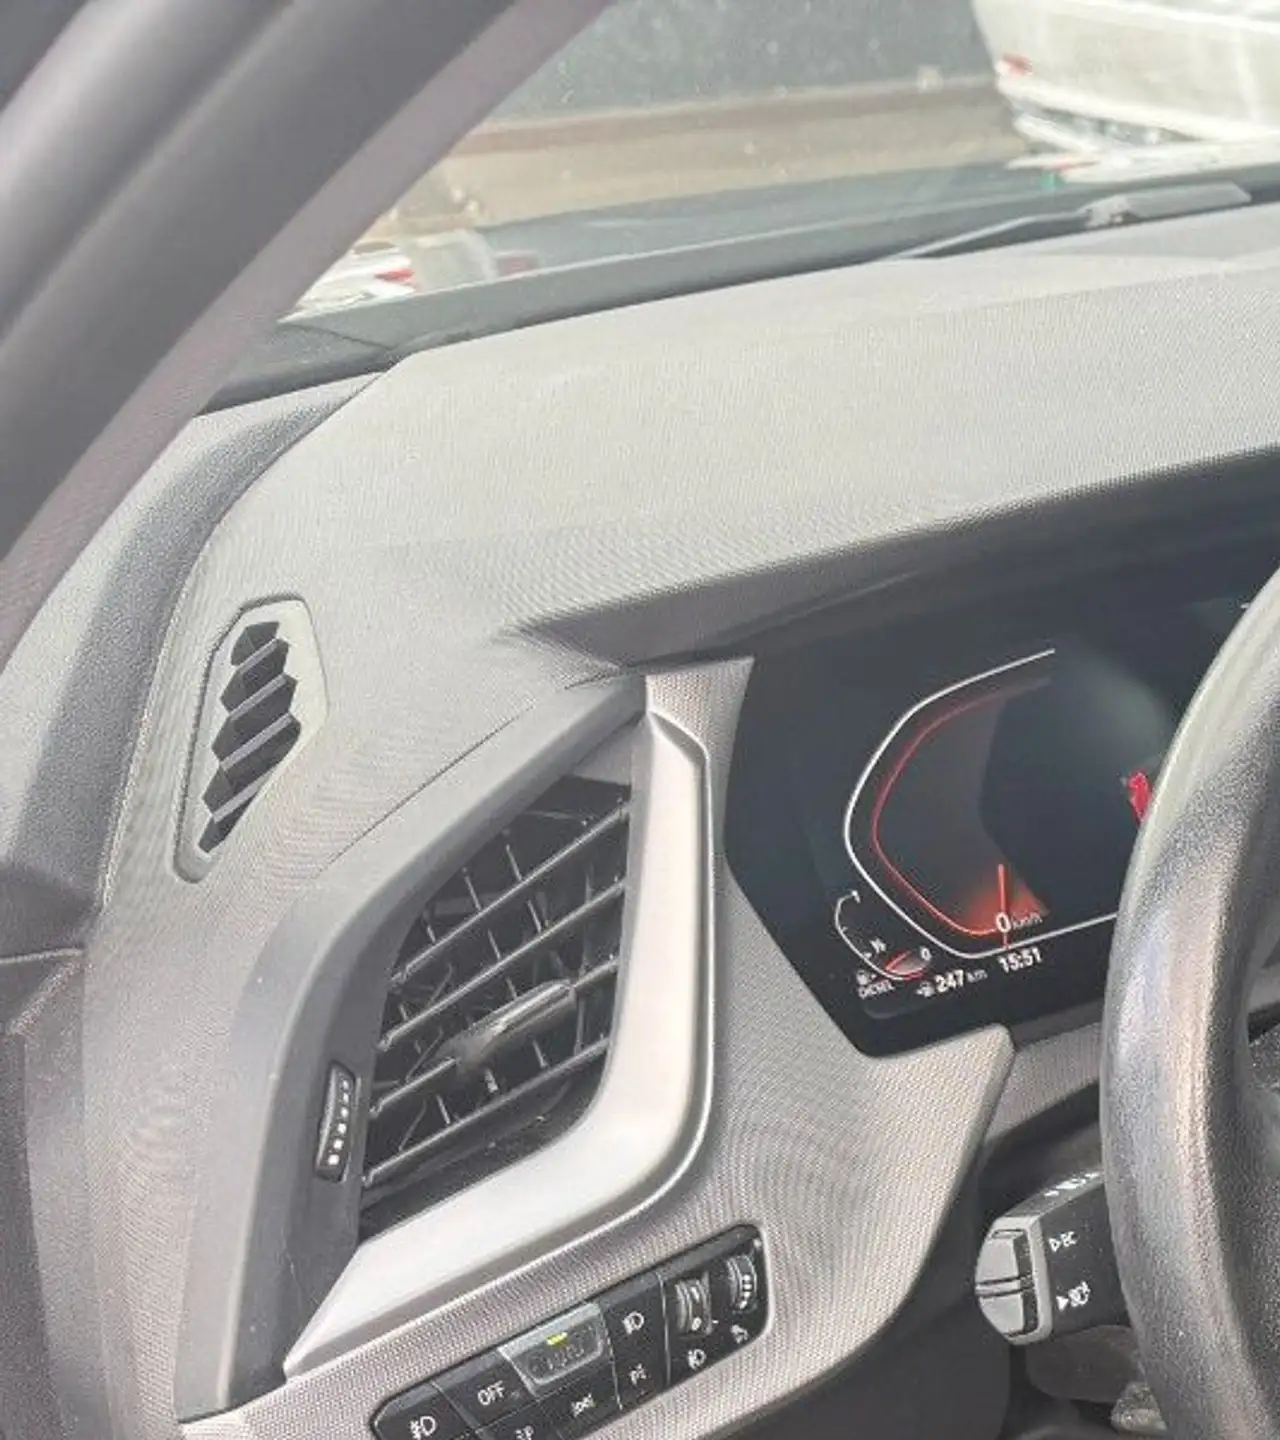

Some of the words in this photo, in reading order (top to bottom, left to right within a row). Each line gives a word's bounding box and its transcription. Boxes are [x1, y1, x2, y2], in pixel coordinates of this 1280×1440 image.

[995, 911, 1012, 934] 0
[998, 946, 1042, 974] 15:51
[934, 968, 965, 993] 247
[477, 1380, 505, 1406] OFF
